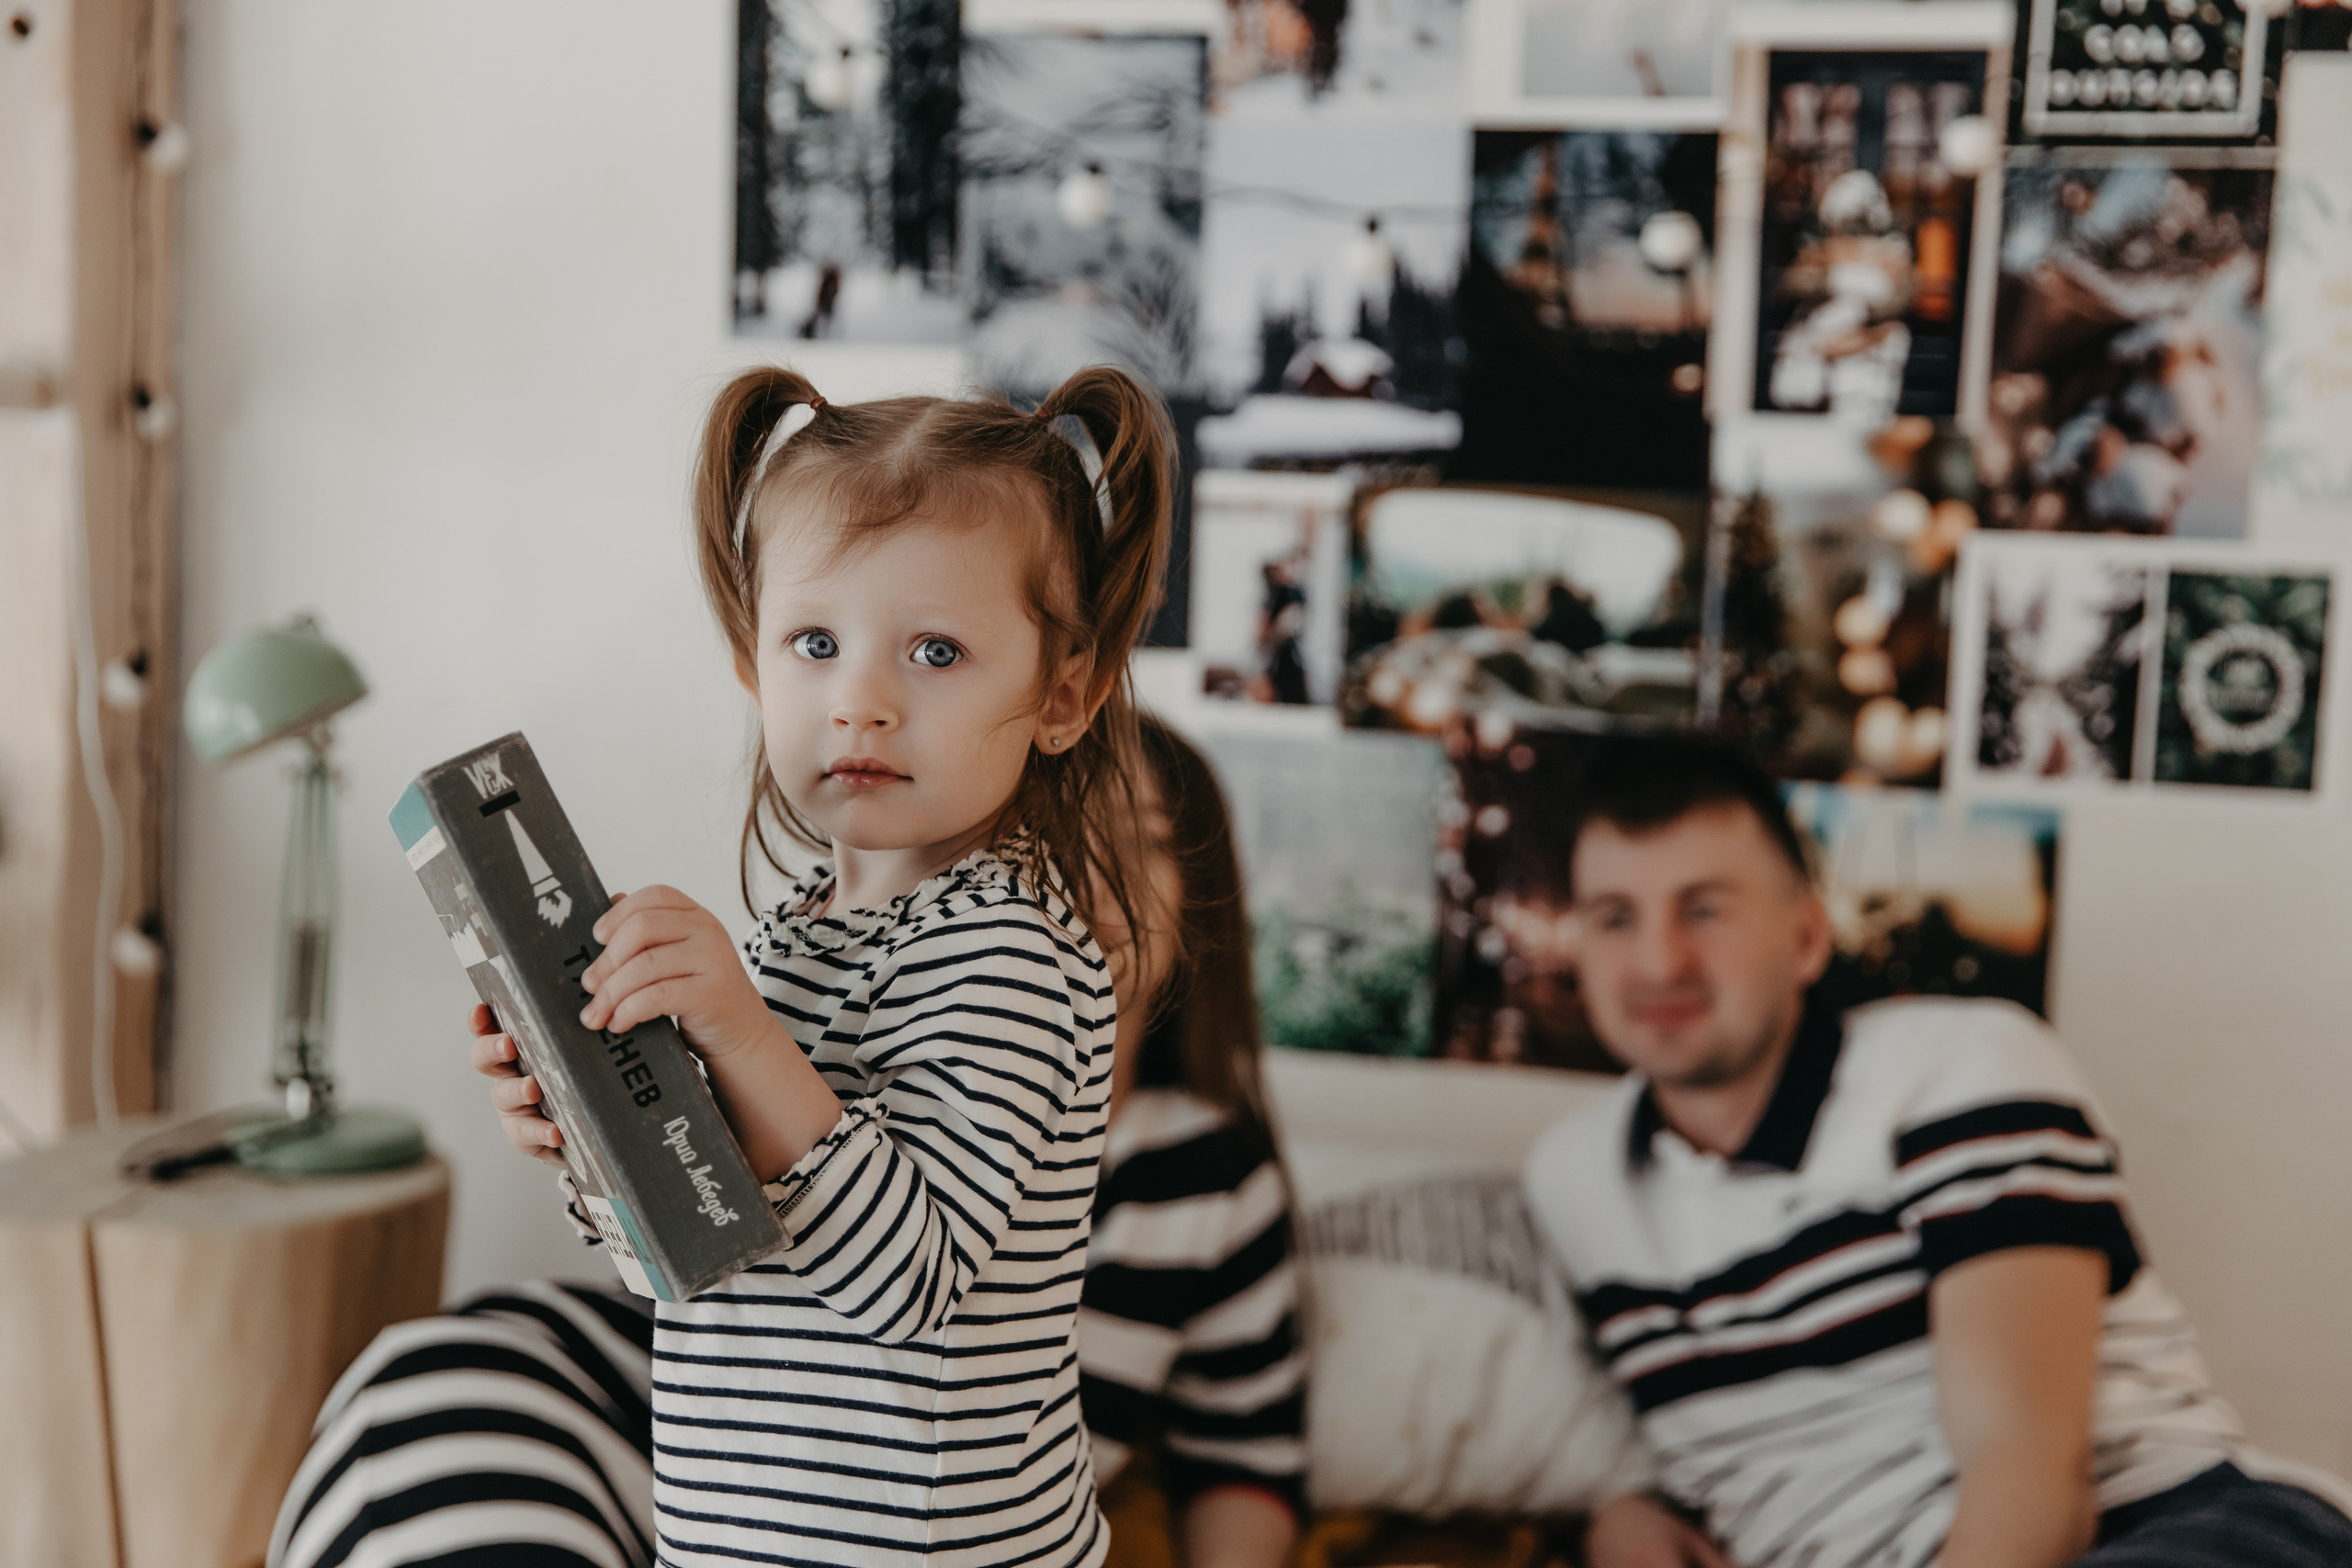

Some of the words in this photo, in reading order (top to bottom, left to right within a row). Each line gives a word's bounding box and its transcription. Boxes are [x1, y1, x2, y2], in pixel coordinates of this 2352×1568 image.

[563, 944, 662, 1108] ТЕНЕВ
[662, 1115, 697, 1164] Юрий
[686, 1164, 740, 1226] Лебедев
